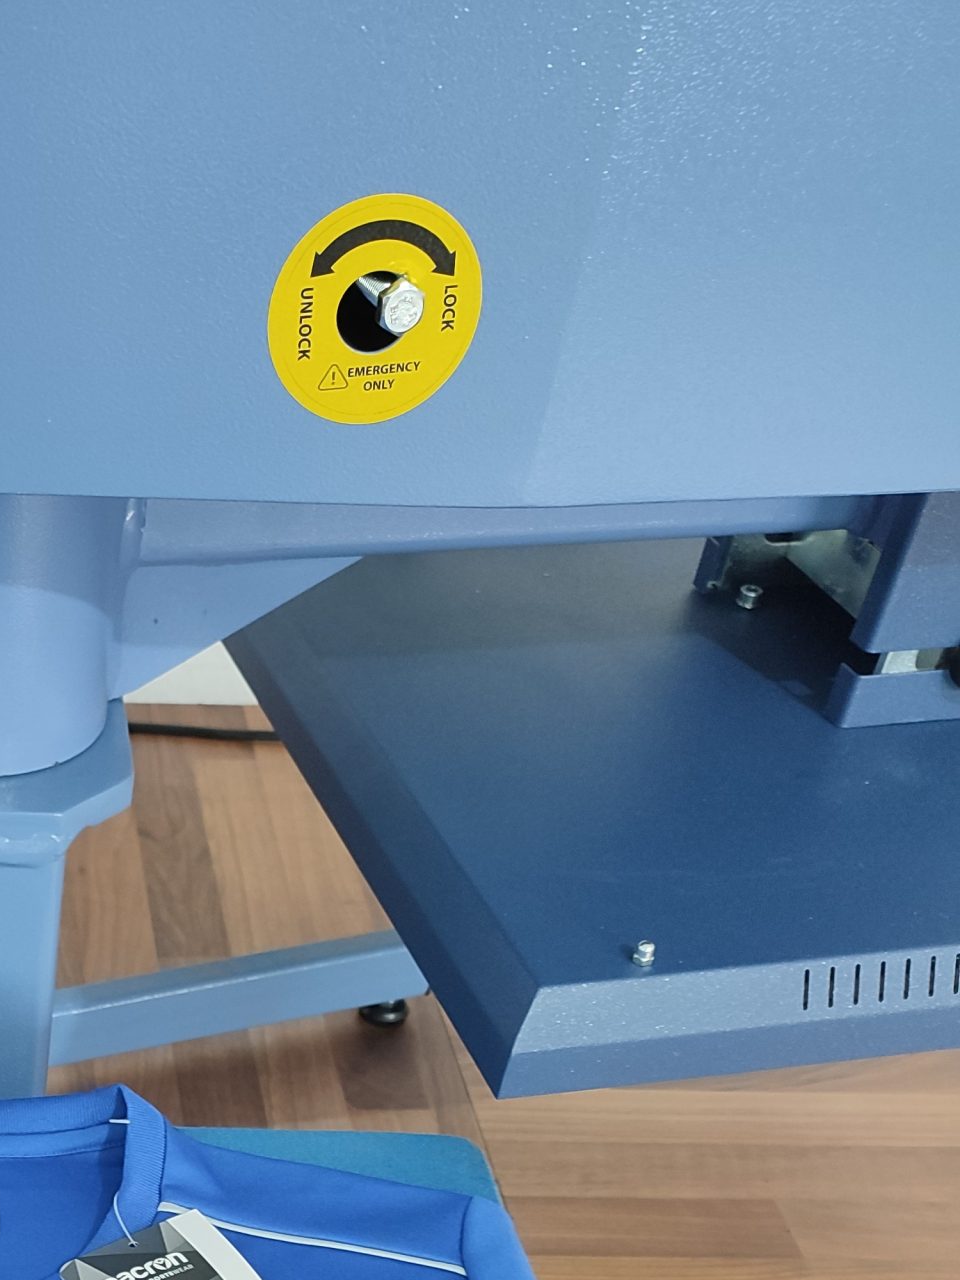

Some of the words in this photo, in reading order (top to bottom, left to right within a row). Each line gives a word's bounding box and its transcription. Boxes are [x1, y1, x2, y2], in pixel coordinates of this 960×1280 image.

[297, 287, 314, 360] UNLOCK
[441, 285, 458, 332] LOCK
[347, 361, 421, 378] EMERGENCY
[363, 378, 395, 391] ONLY
